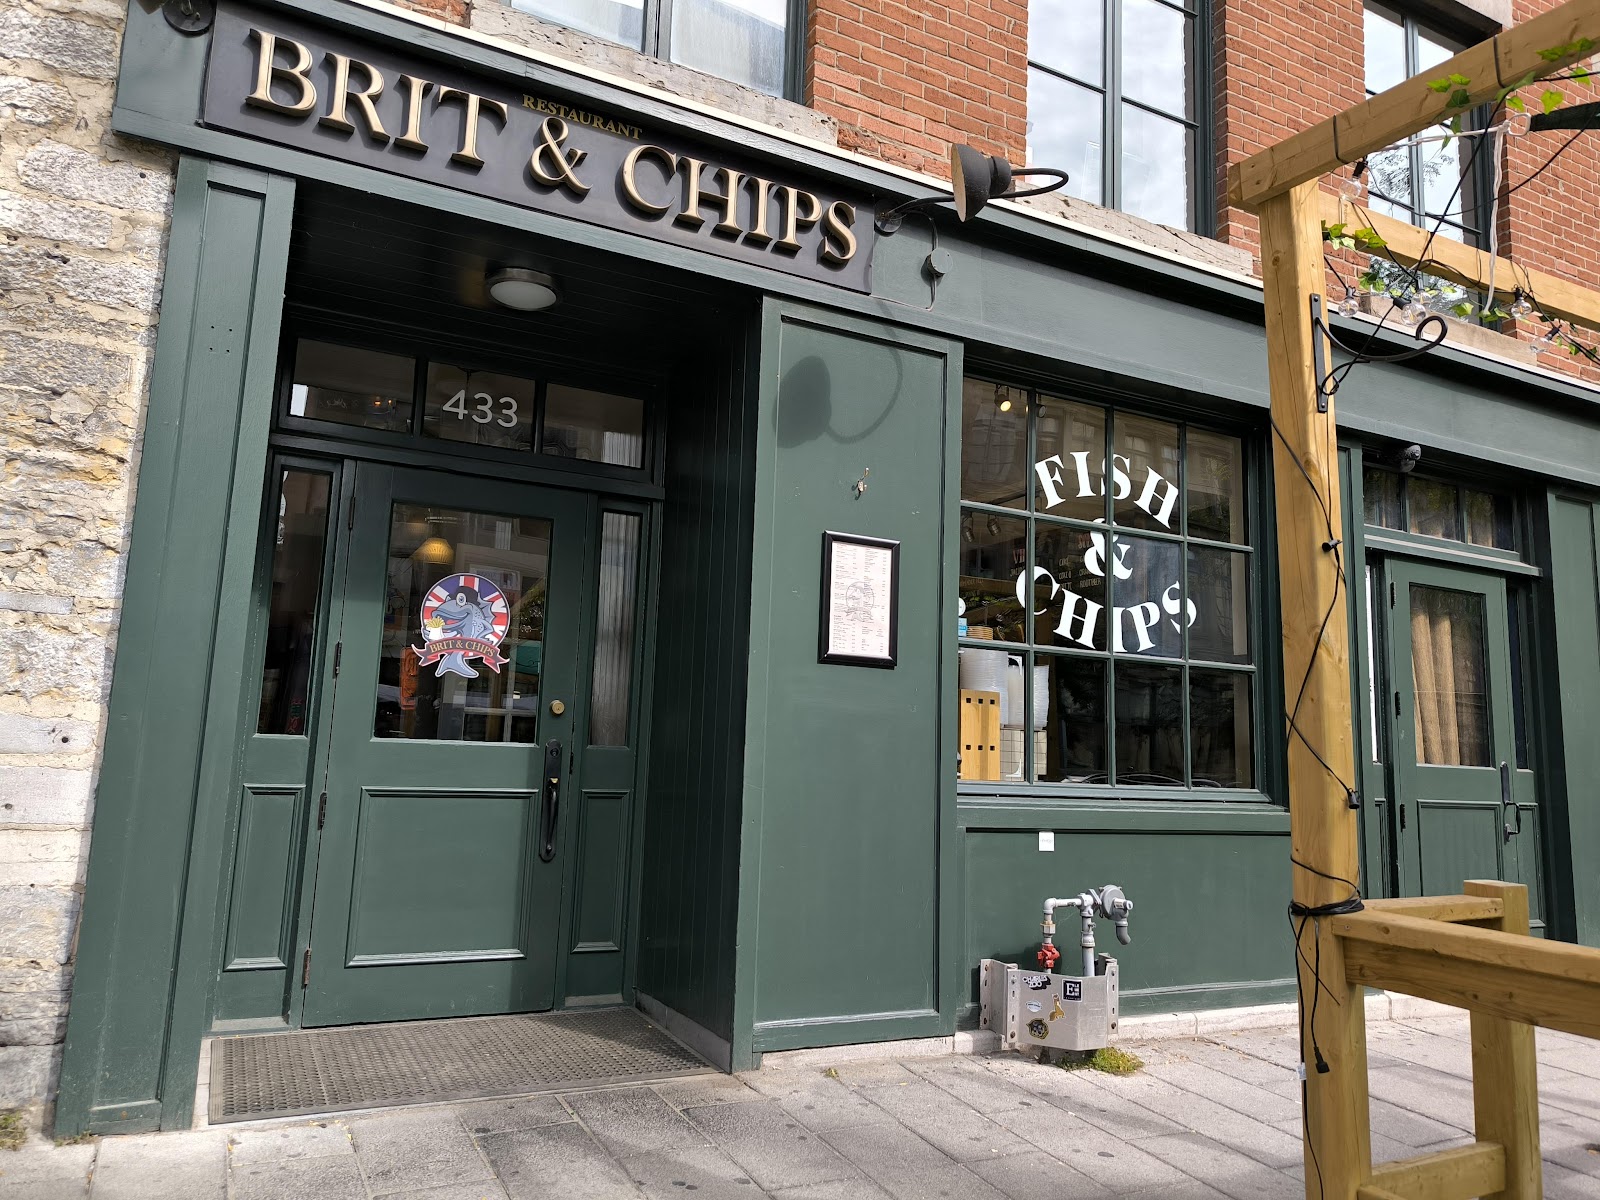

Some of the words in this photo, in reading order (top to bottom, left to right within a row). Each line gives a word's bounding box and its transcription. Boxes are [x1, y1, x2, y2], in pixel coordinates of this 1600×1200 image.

[246, 28, 507, 169] BRIT
[529, 117, 593, 196] &
[622, 144, 857, 265] CHIPS
[522, 94, 642, 140] RESTAURANT
[442, 389, 518, 428] 433
[1035, 451, 1179, 529] FISH
[1084, 517, 1133, 580] &
[1016, 566, 1197, 653] CHIPS
[429, 640, 454, 653] BRIT
[456, 640, 463, 649] &
[465, 641, 495, 657] CHIPS
